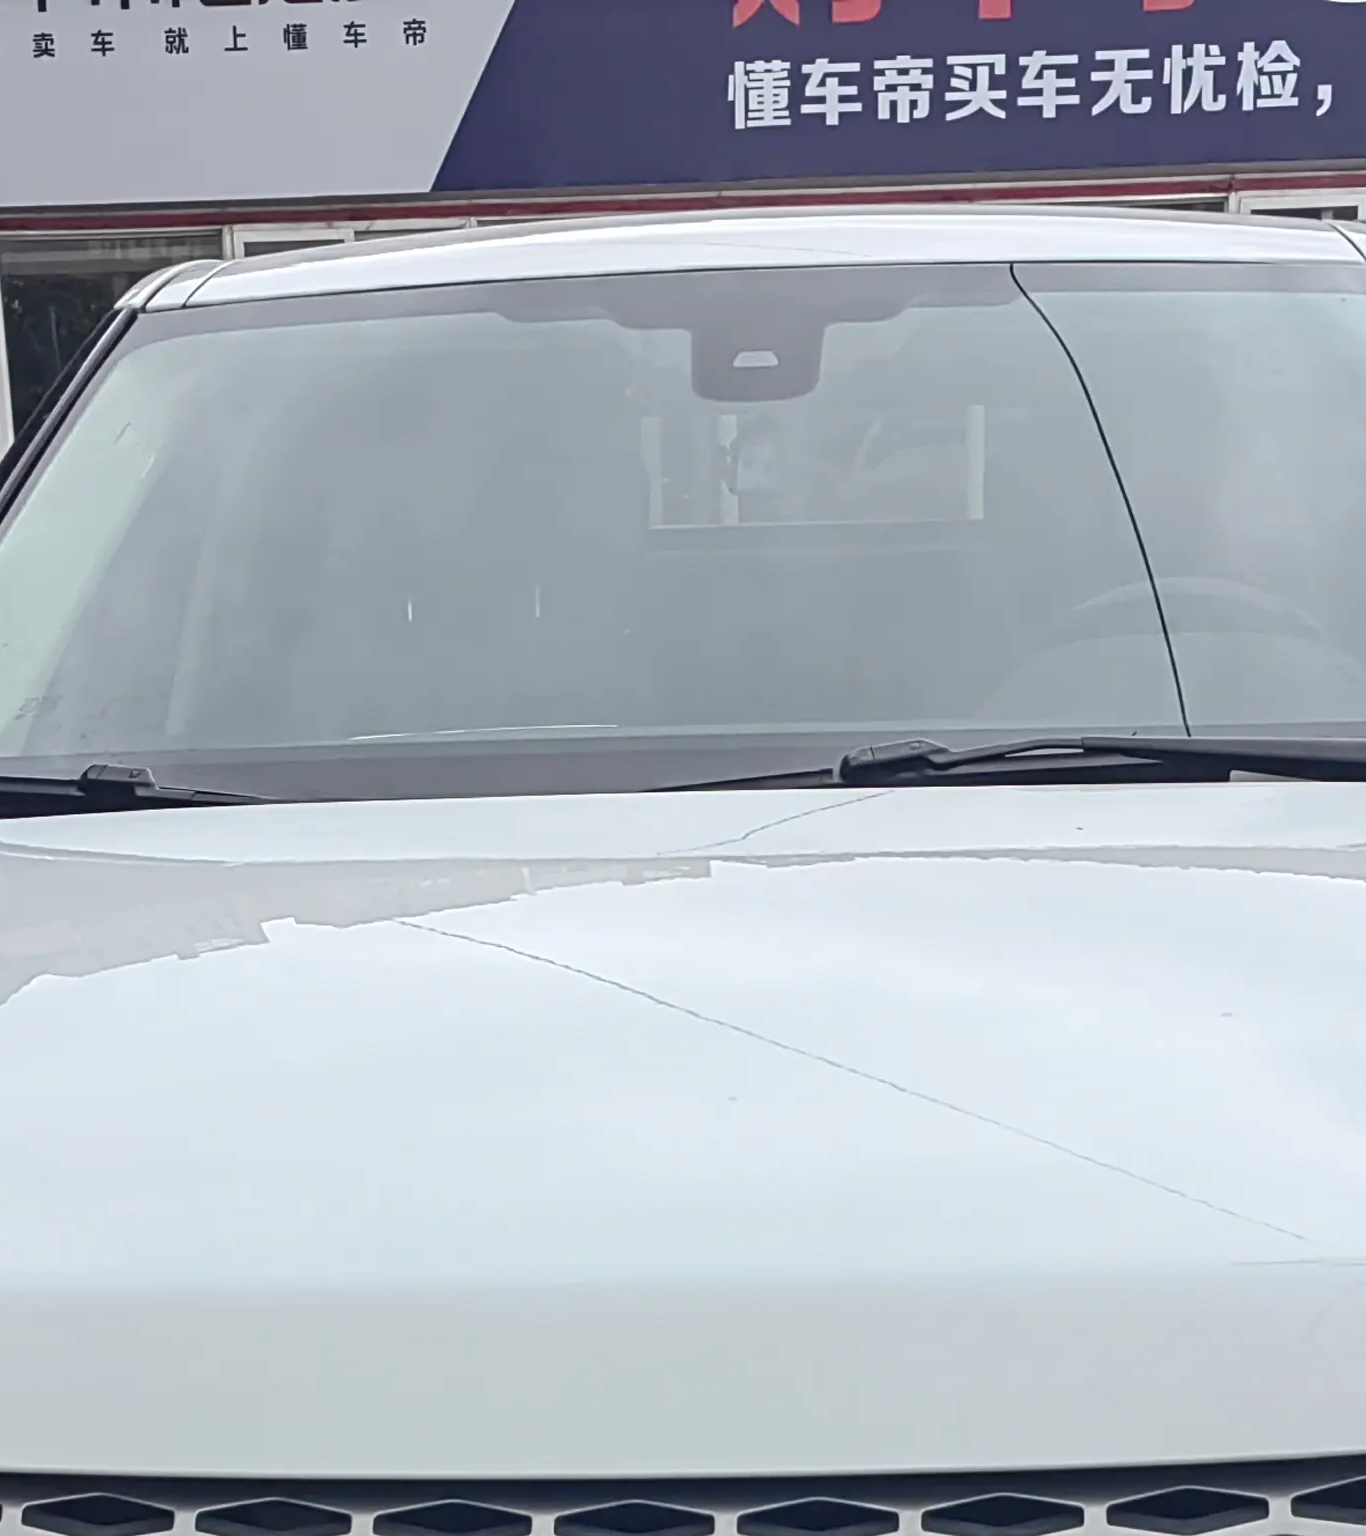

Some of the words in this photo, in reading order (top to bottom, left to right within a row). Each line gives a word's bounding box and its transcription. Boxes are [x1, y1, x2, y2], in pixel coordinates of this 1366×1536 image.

[163, 18, 428, 56] 就上懂车帝
